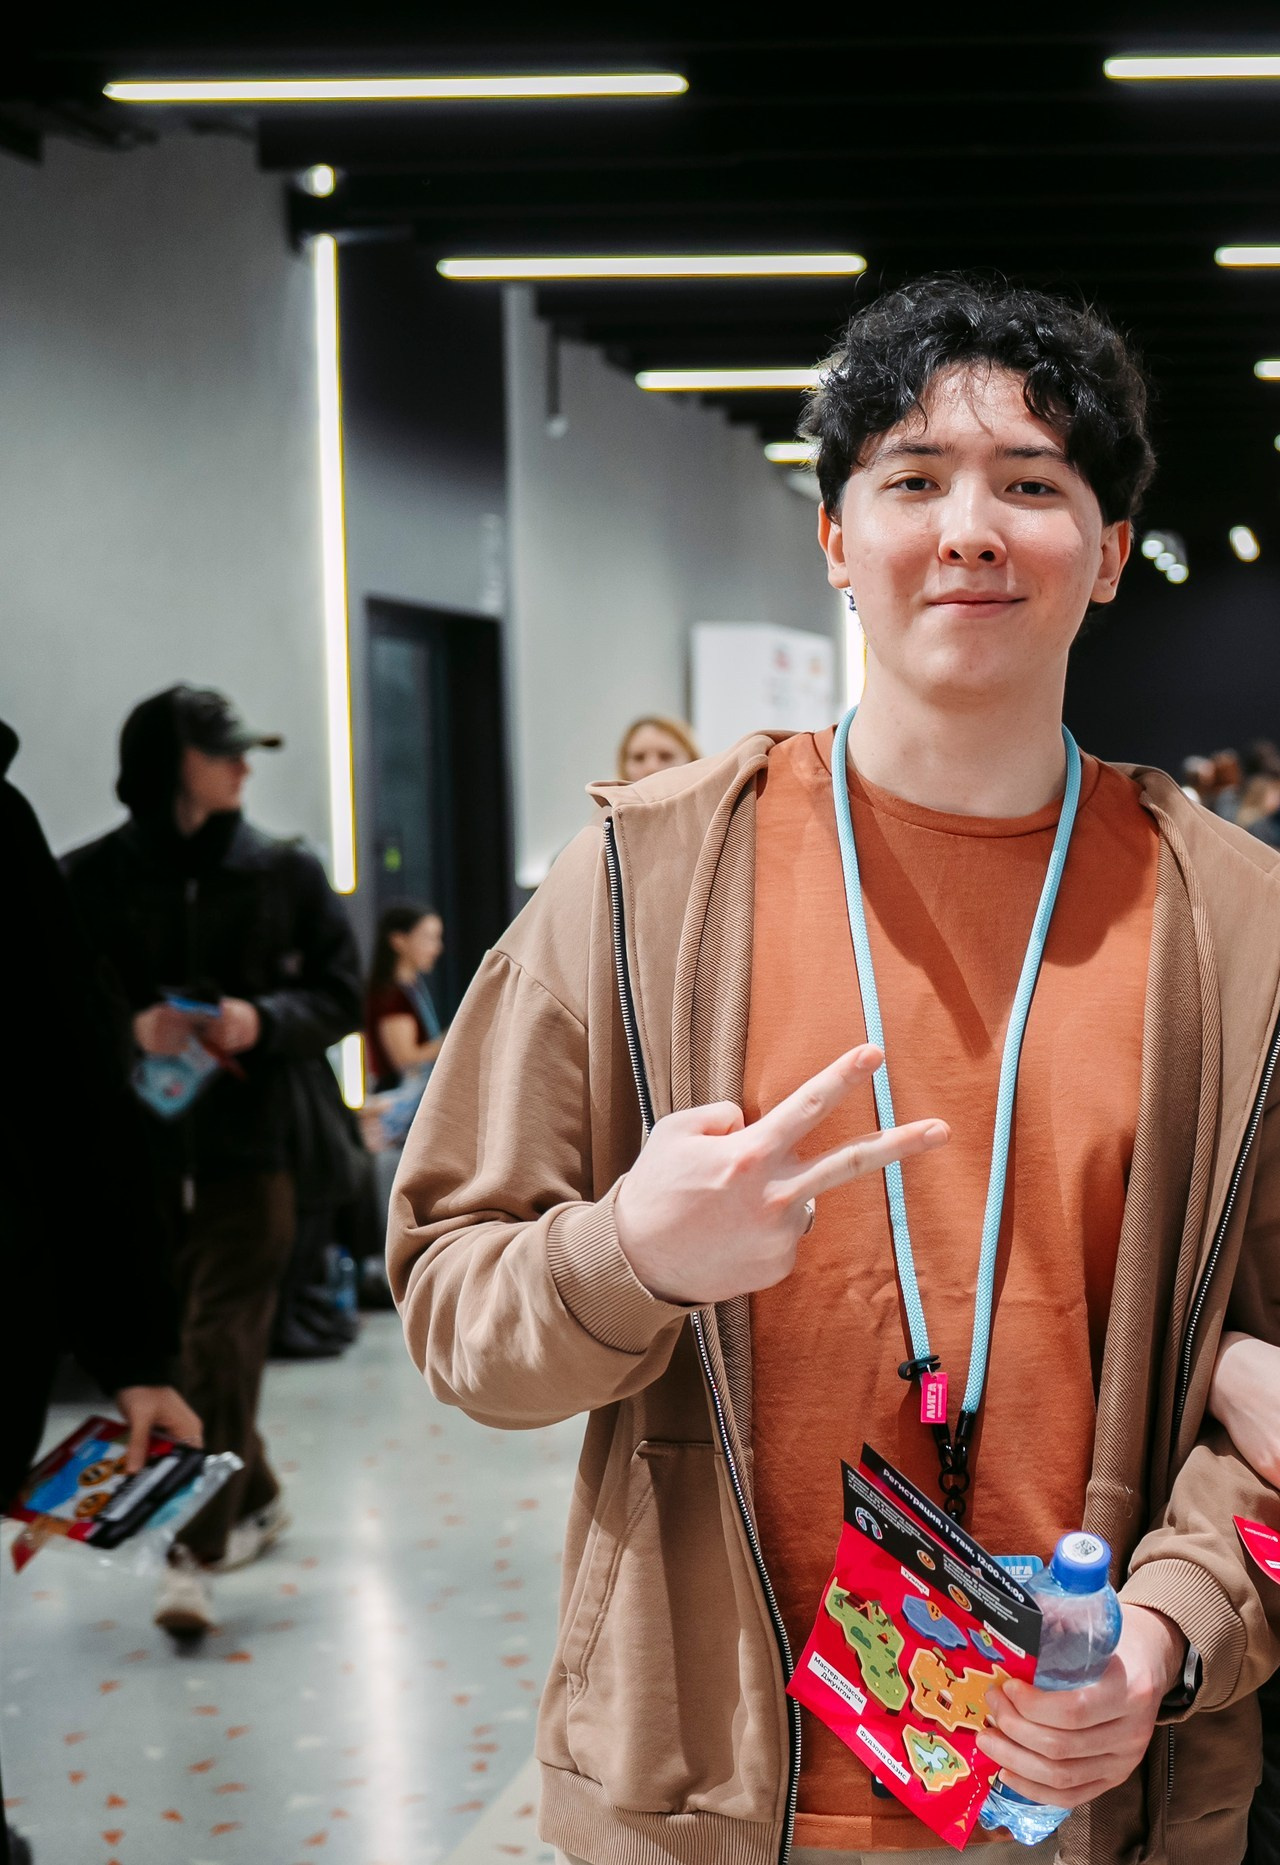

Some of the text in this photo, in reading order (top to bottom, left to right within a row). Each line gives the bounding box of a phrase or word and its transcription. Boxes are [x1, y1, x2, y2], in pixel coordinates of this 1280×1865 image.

[926, 1383, 937, 1419] ЛИГА
[883, 1468, 944, 1529] Регистрация,
[950, 1531, 975, 1558] этаж,
[977, 1553, 1025, 1603] 12:00-14:00
[1004, 1565, 1033, 1575] ИГА
[814, 1656, 864, 1704] Мастер-классы
[820, 1671, 851, 1701] Джунгли
[860, 1729, 907, 1780] Фудзона Оазис
